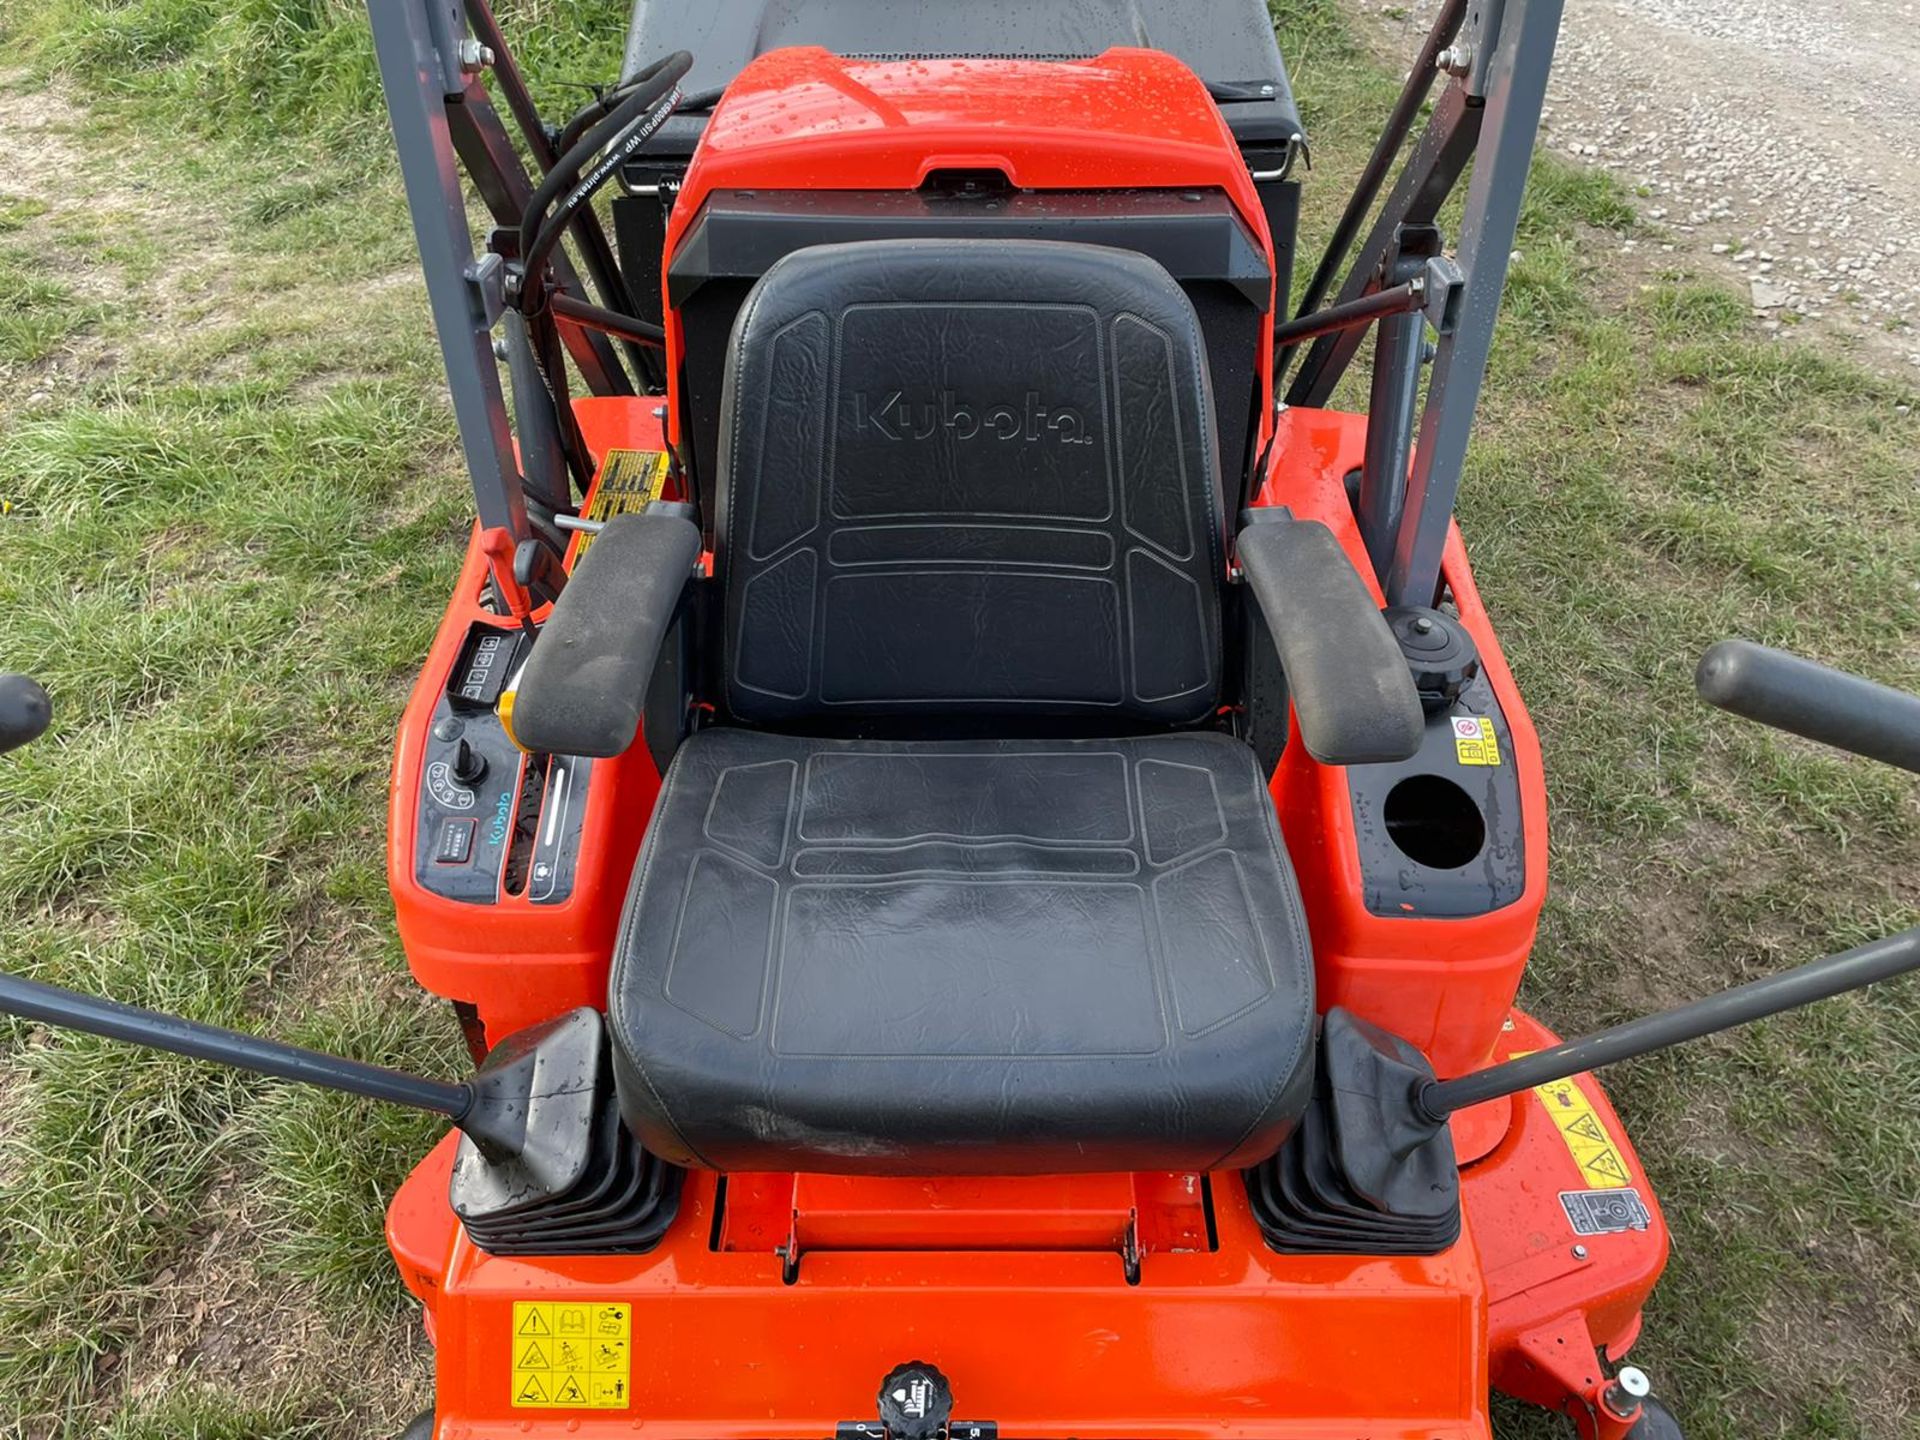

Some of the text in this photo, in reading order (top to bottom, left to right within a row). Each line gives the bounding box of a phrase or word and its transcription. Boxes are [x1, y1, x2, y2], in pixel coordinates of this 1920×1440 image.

[625, 135, 642, 153] WP
[567, 153, 621, 208] www.pirtek.eu
[855, 391, 1084, 443] Kubota
[1481, 720, 1498, 763] DIESEL
[488, 792, 511, 845] Kubota
